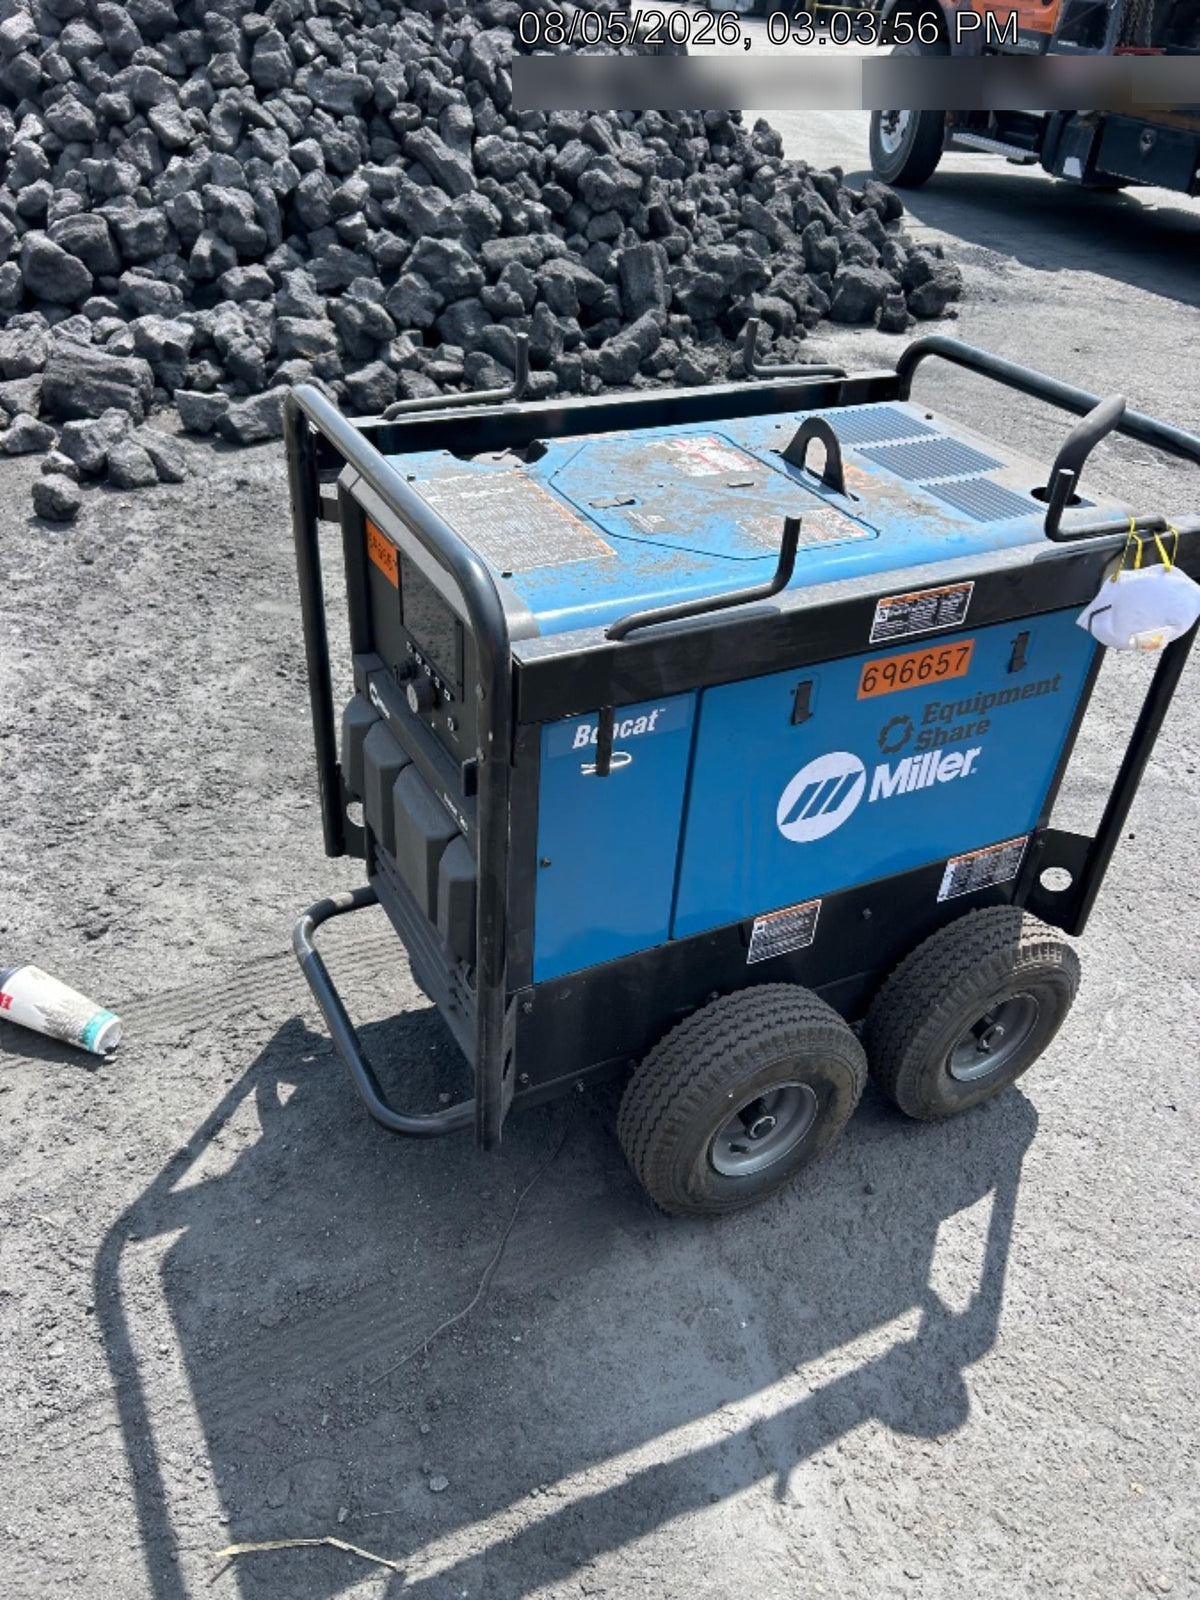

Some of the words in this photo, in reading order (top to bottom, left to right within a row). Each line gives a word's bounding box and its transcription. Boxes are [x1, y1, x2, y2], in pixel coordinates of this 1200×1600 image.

[862, 647, 969, 692] 696657
[922, 673, 1062, 723] Equipment
[915, 718, 991, 751] Share
